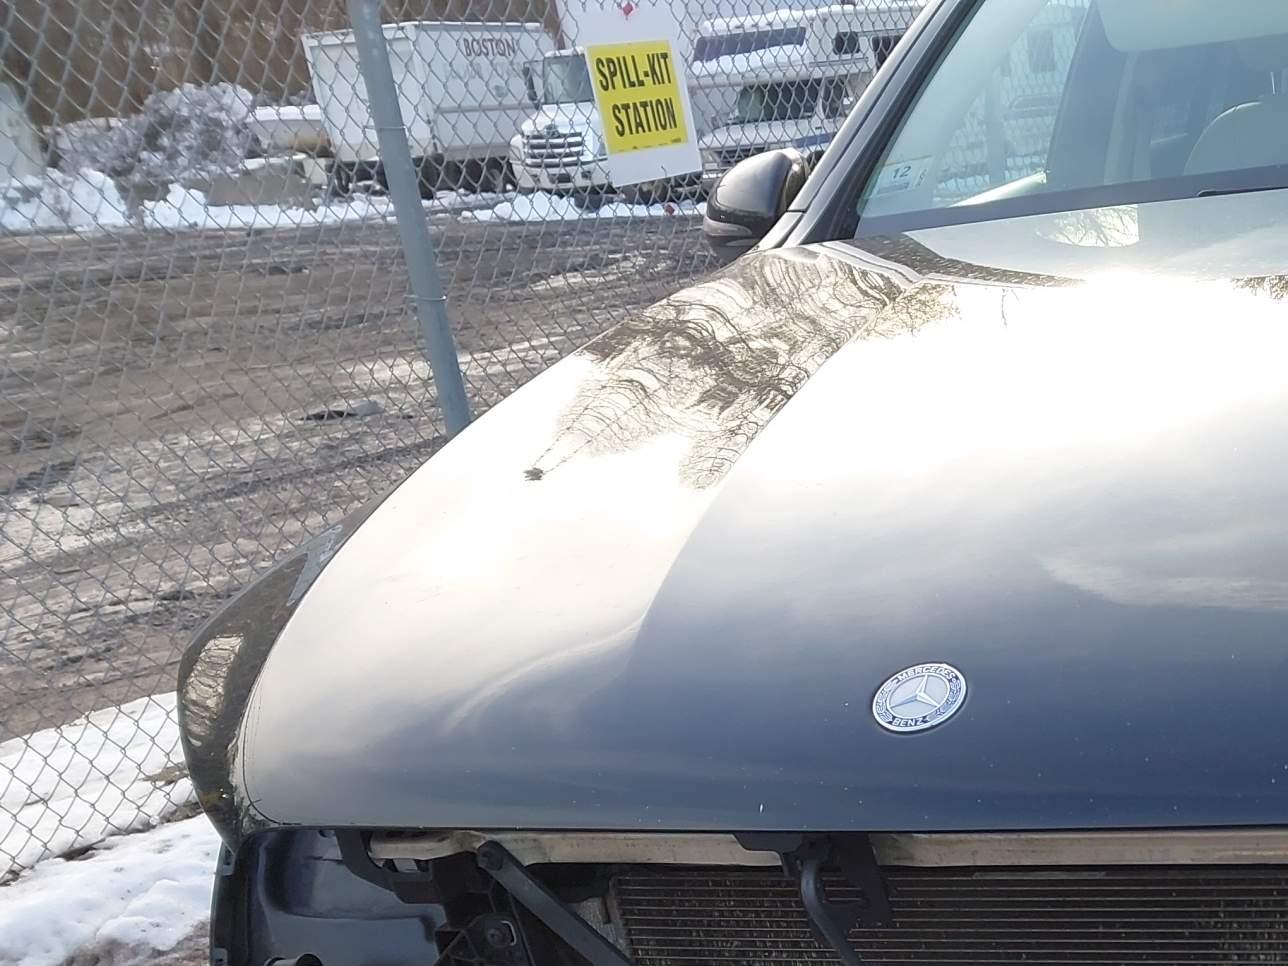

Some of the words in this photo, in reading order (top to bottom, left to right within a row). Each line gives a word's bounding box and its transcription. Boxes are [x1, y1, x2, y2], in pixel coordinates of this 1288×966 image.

[463, 37, 515, 57] BOSTON
[595, 52, 671, 91] SPILL-KIT
[611, 97, 677, 137] STATION
[893, 165, 912, 178] 12
[897, 665, 956, 682] MERCEDES
[892, 717, 929, 727] BENZ
